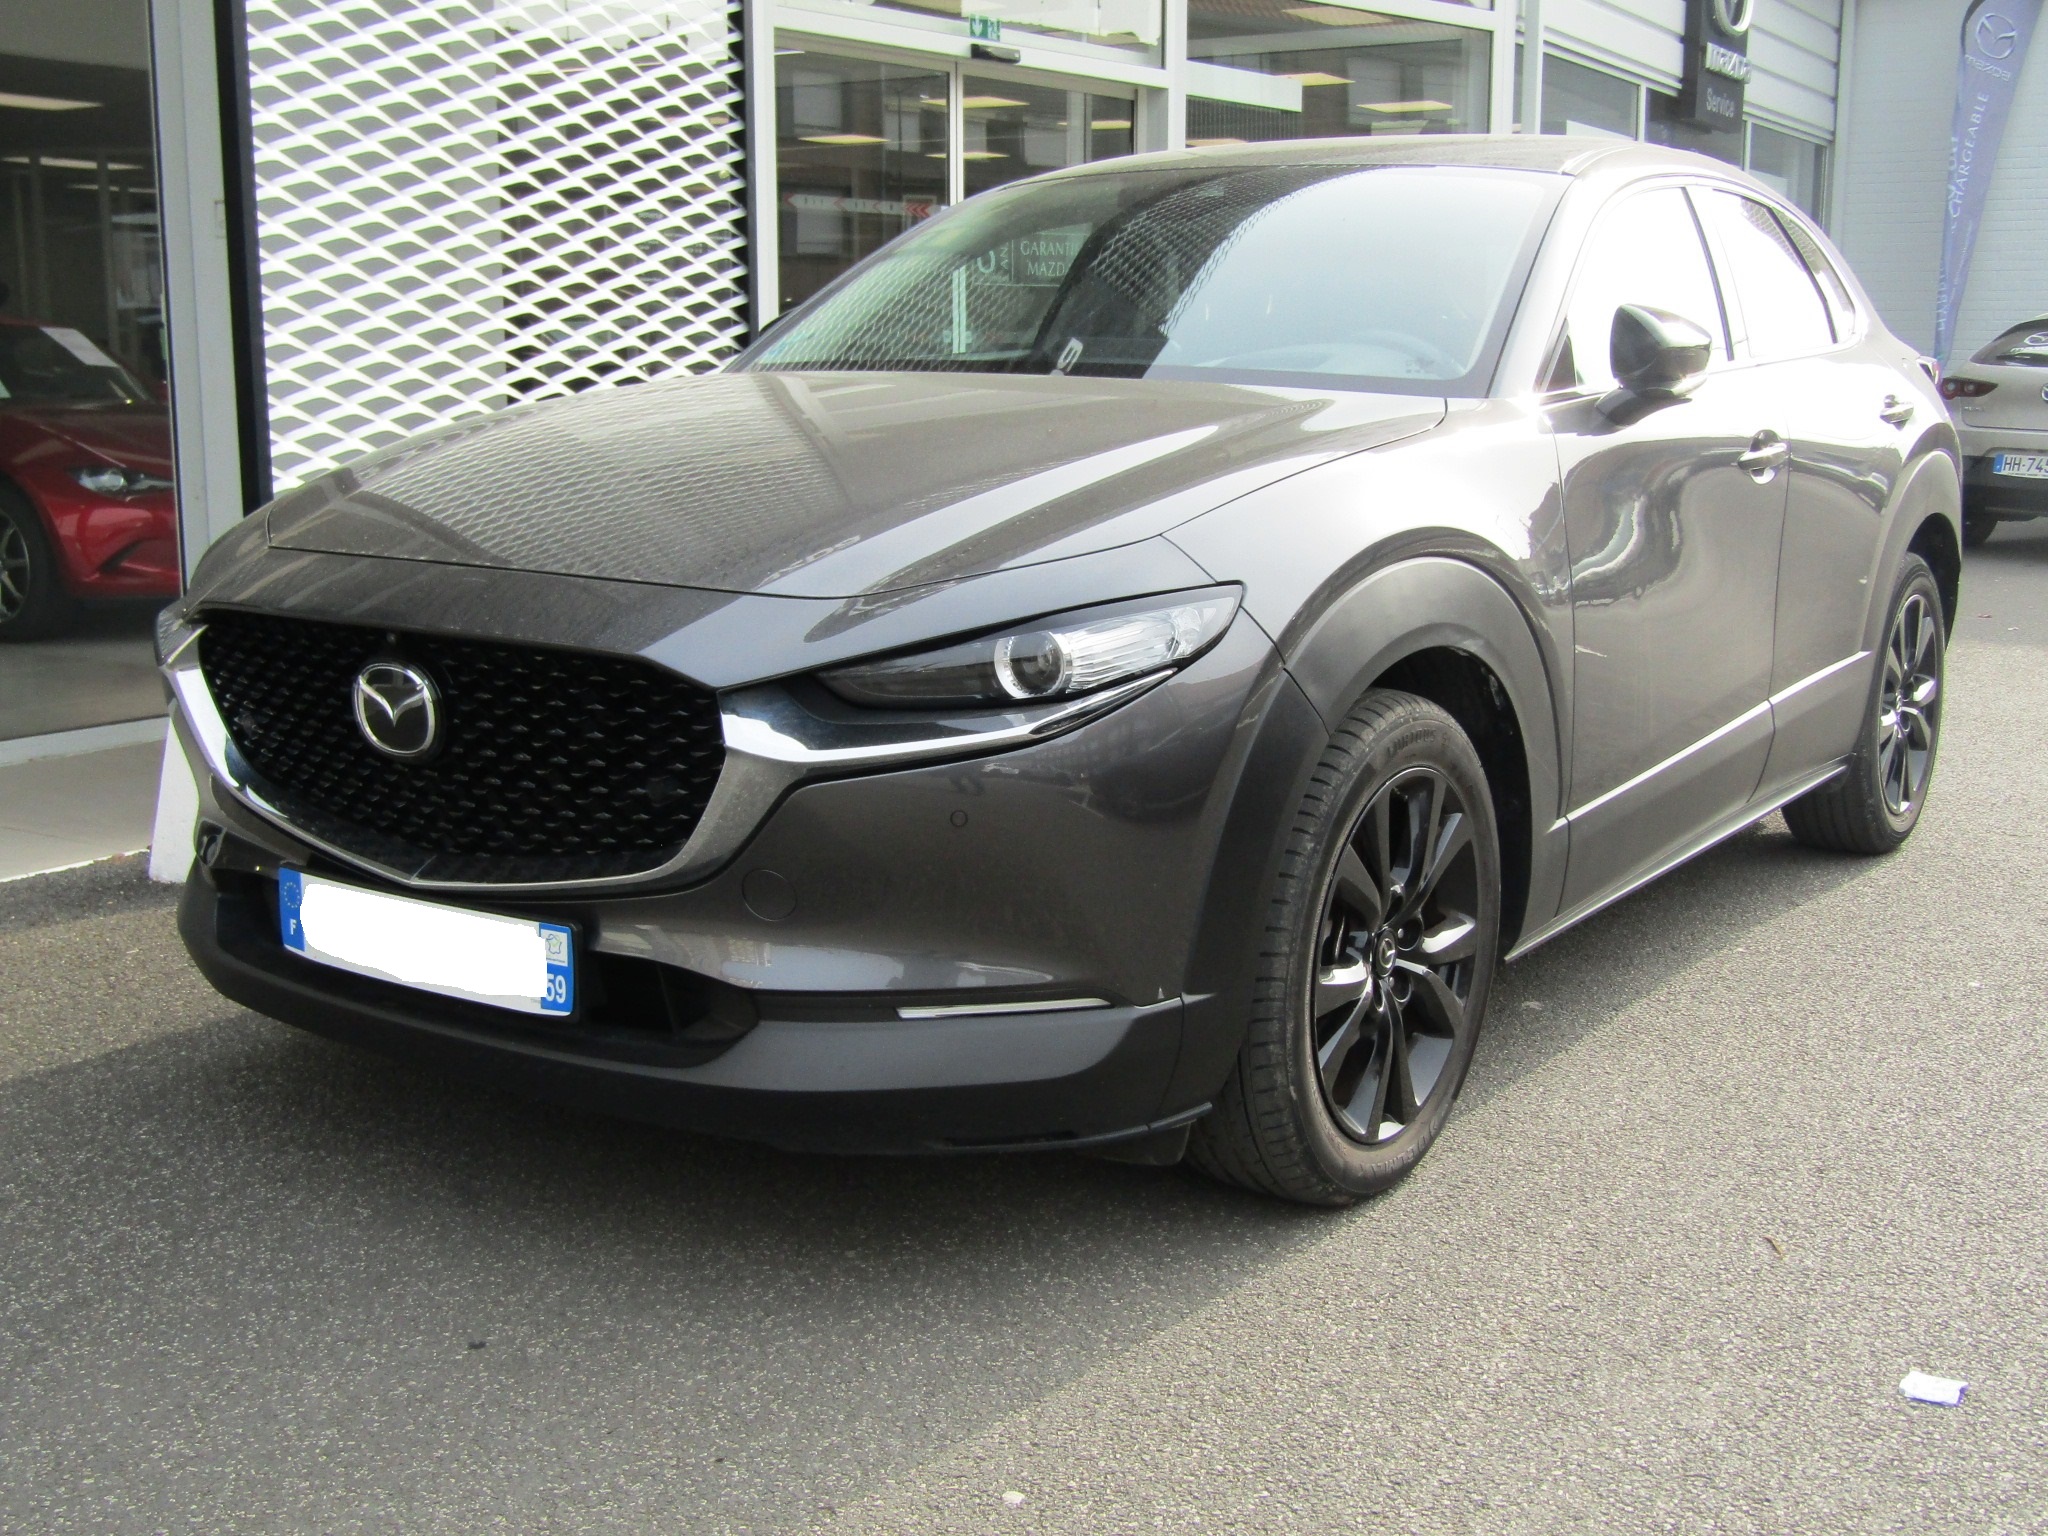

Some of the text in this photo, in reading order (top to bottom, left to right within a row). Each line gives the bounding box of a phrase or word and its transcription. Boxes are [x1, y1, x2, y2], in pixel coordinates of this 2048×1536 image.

[1706, 87, 1735, 118] Service
[1949, 91, 1990, 233] CHARGEABLE
[290, 918, 297, 935] F
[546, 973, 567, 1004] 59
